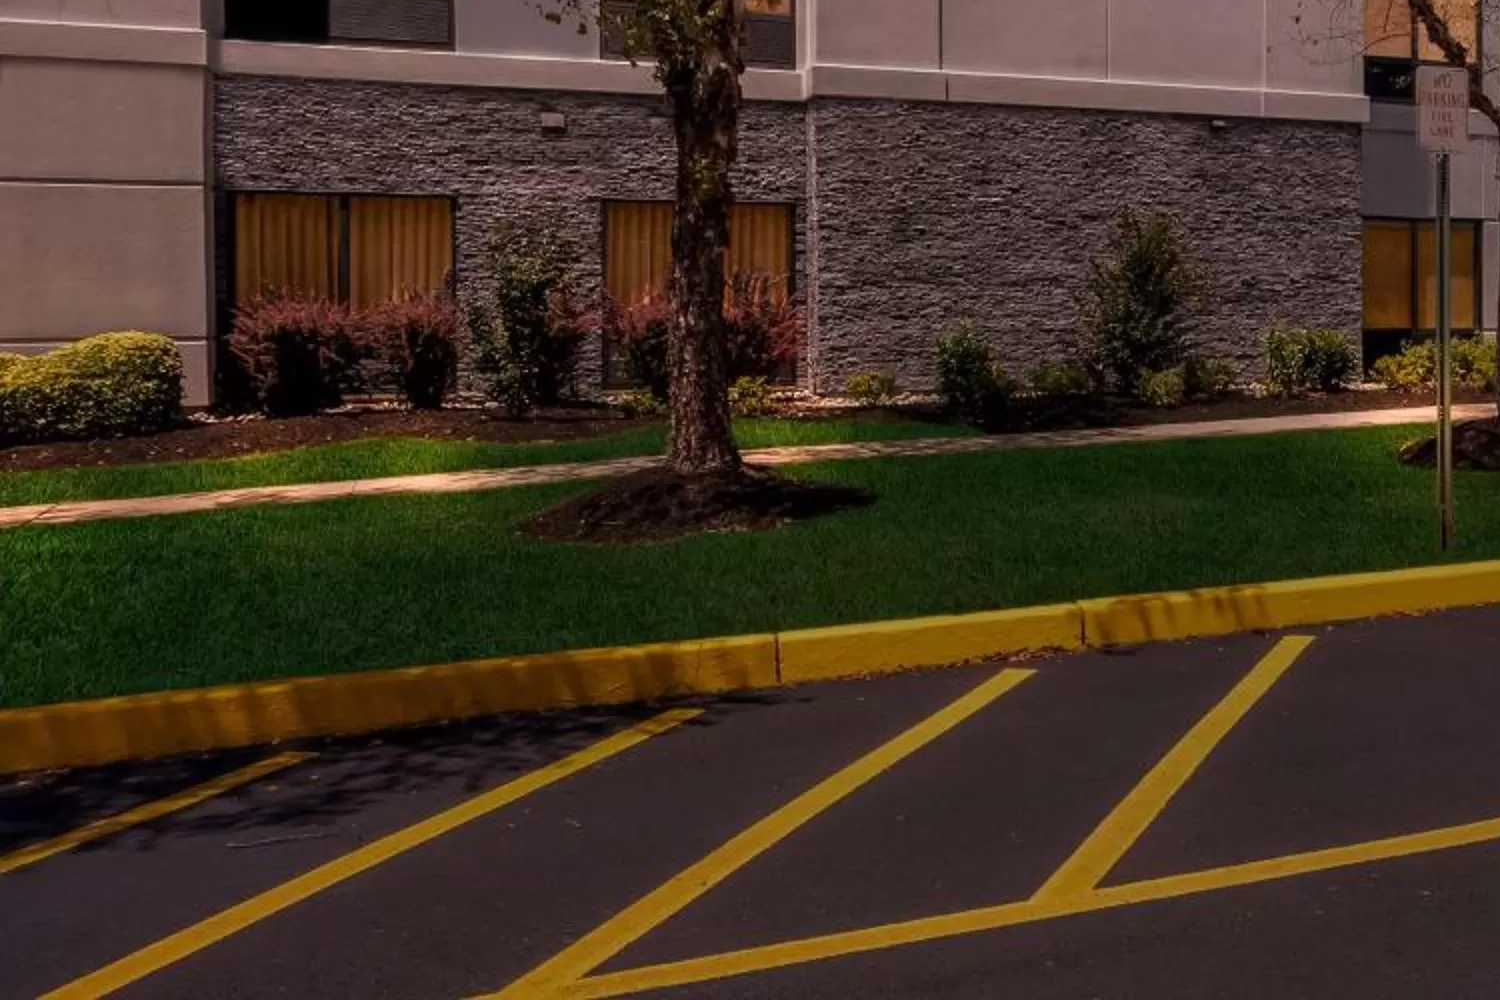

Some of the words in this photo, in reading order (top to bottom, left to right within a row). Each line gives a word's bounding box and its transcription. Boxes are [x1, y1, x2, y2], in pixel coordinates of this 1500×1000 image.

[1433, 73, 1452, 89] NO
[1419, 91, 1466, 108] PARKING
[1431, 111, 1454, 122] FIRE
[1430, 125, 1455, 137] LANE
